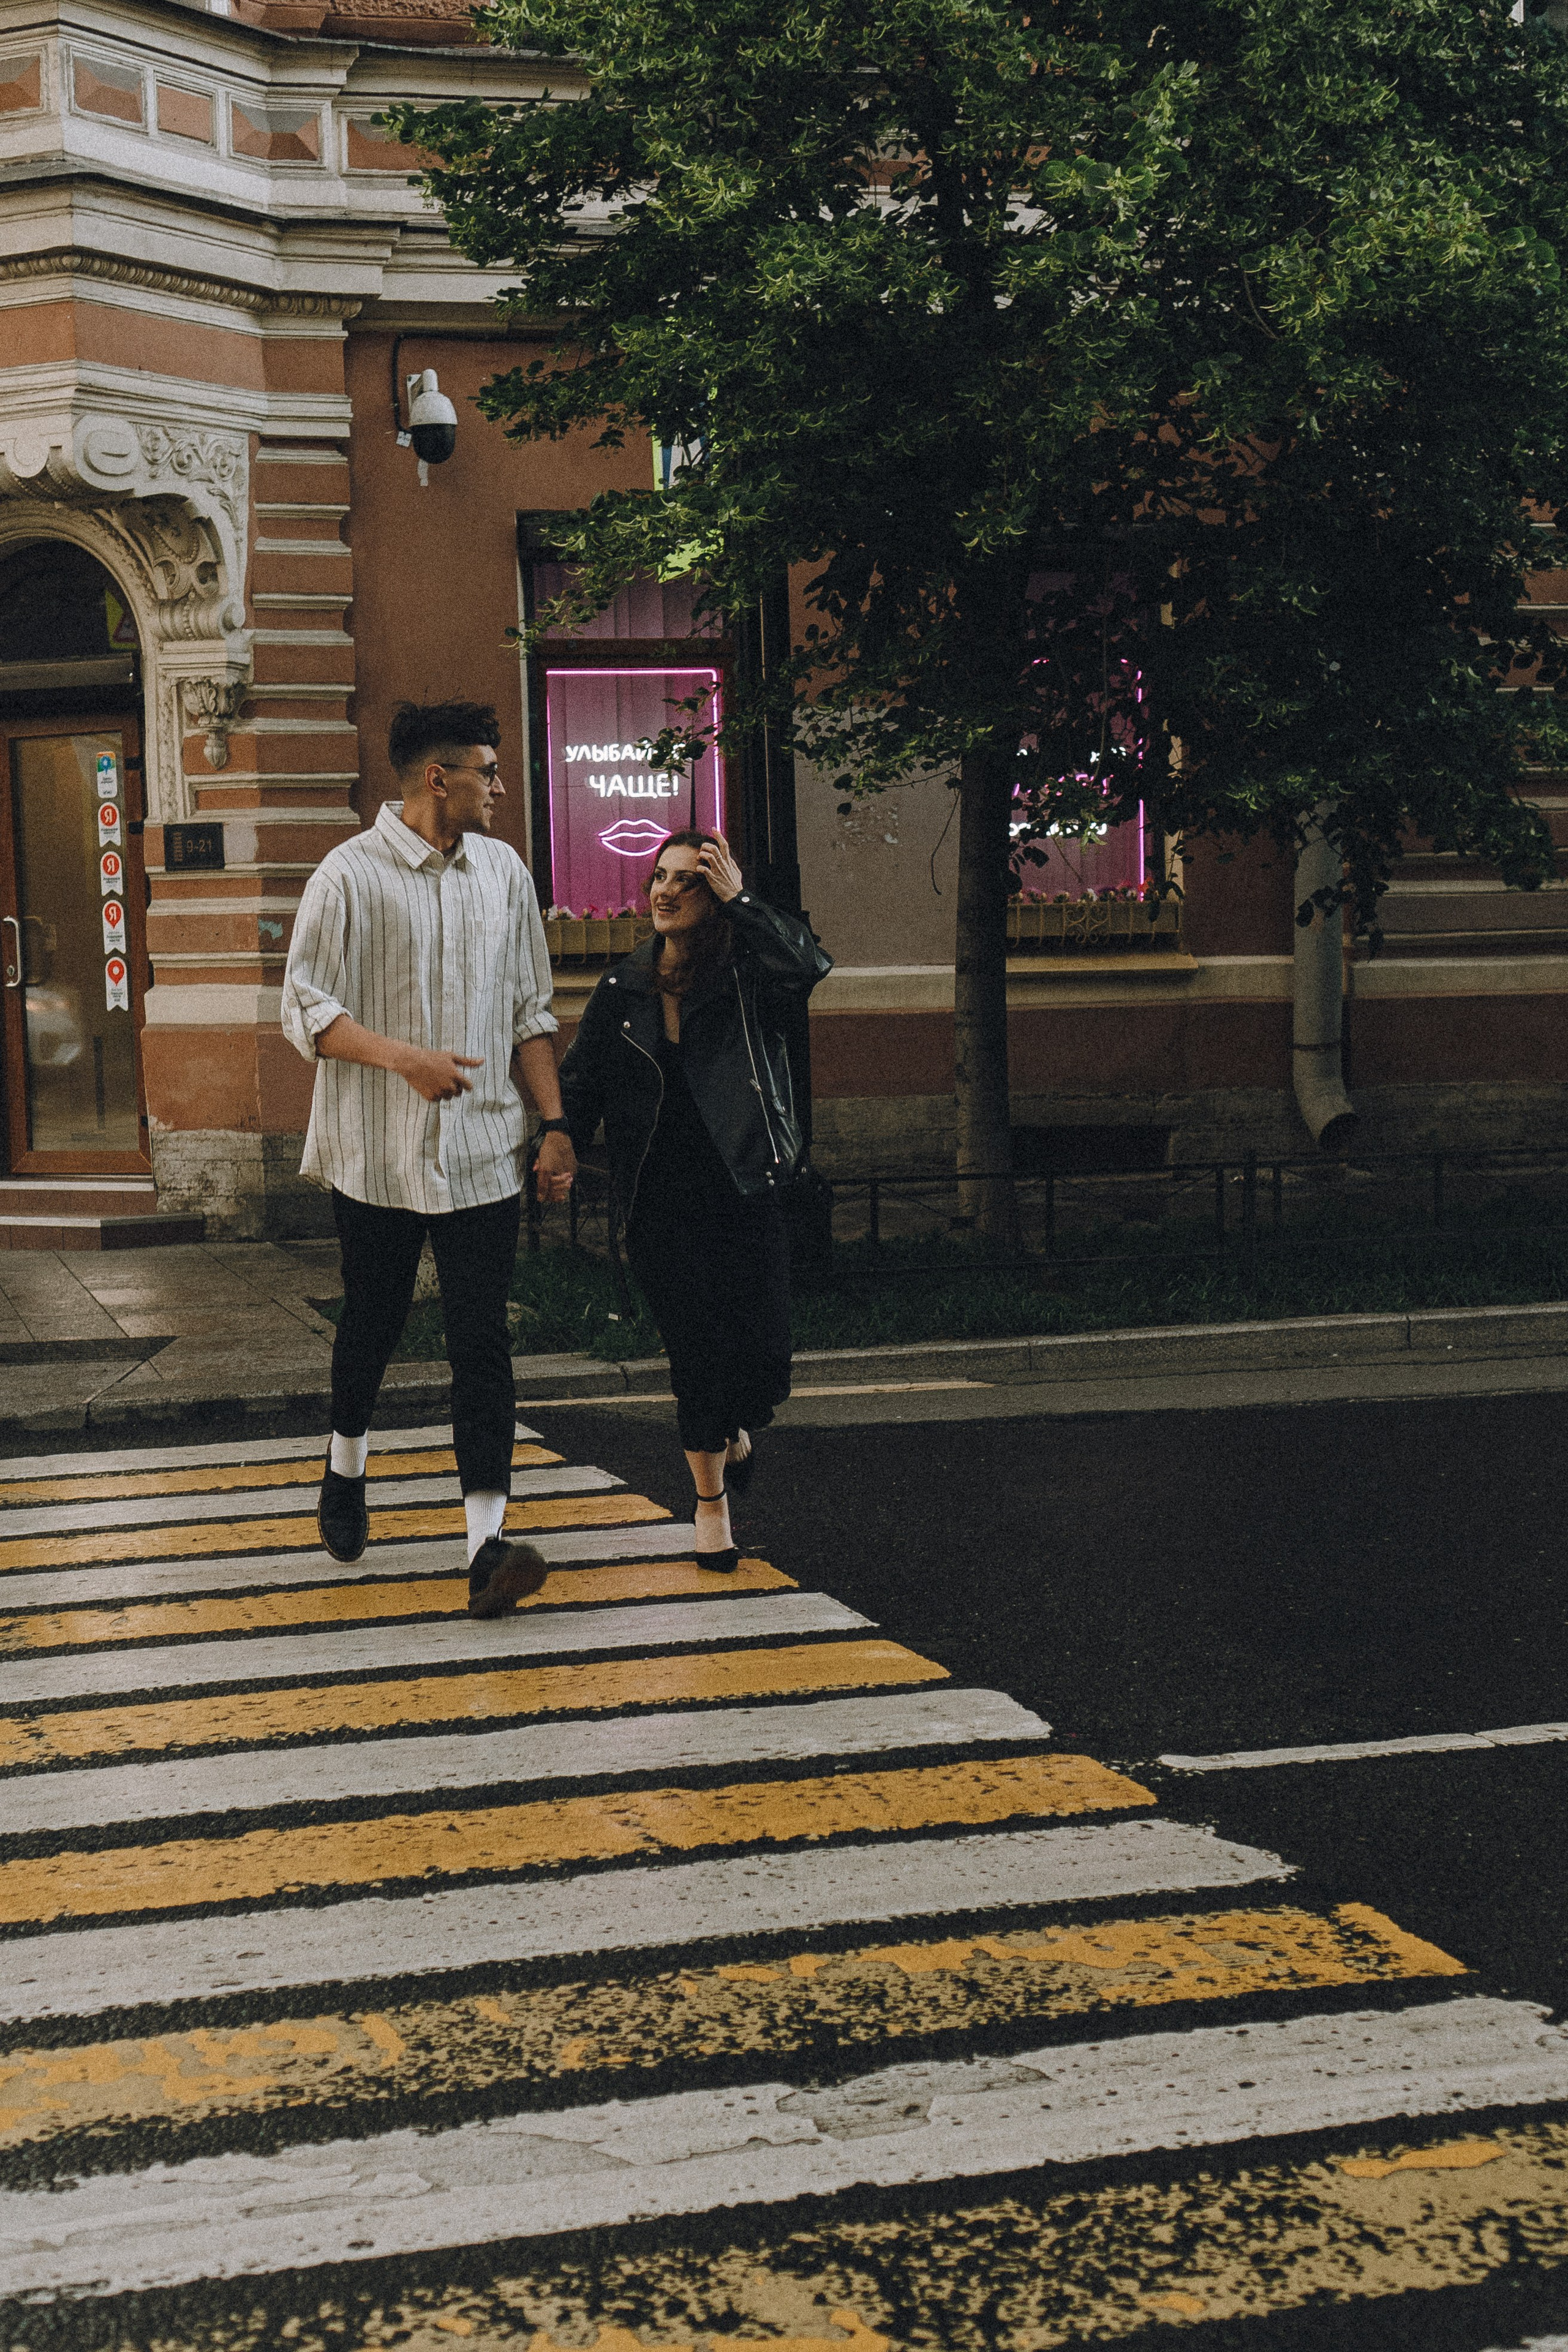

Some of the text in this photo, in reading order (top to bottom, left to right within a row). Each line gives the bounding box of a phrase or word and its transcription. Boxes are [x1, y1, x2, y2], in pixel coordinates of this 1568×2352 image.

[565, 740, 688, 763] УЛЫБАЙ
[589, 773, 679, 799] ЧАЩЕ!
[104, 808, 112, 823] Я
[186, 840, 212, 853] 9-21
[107, 857, 115, 873] Я
[109, 906, 116, 921] Я
